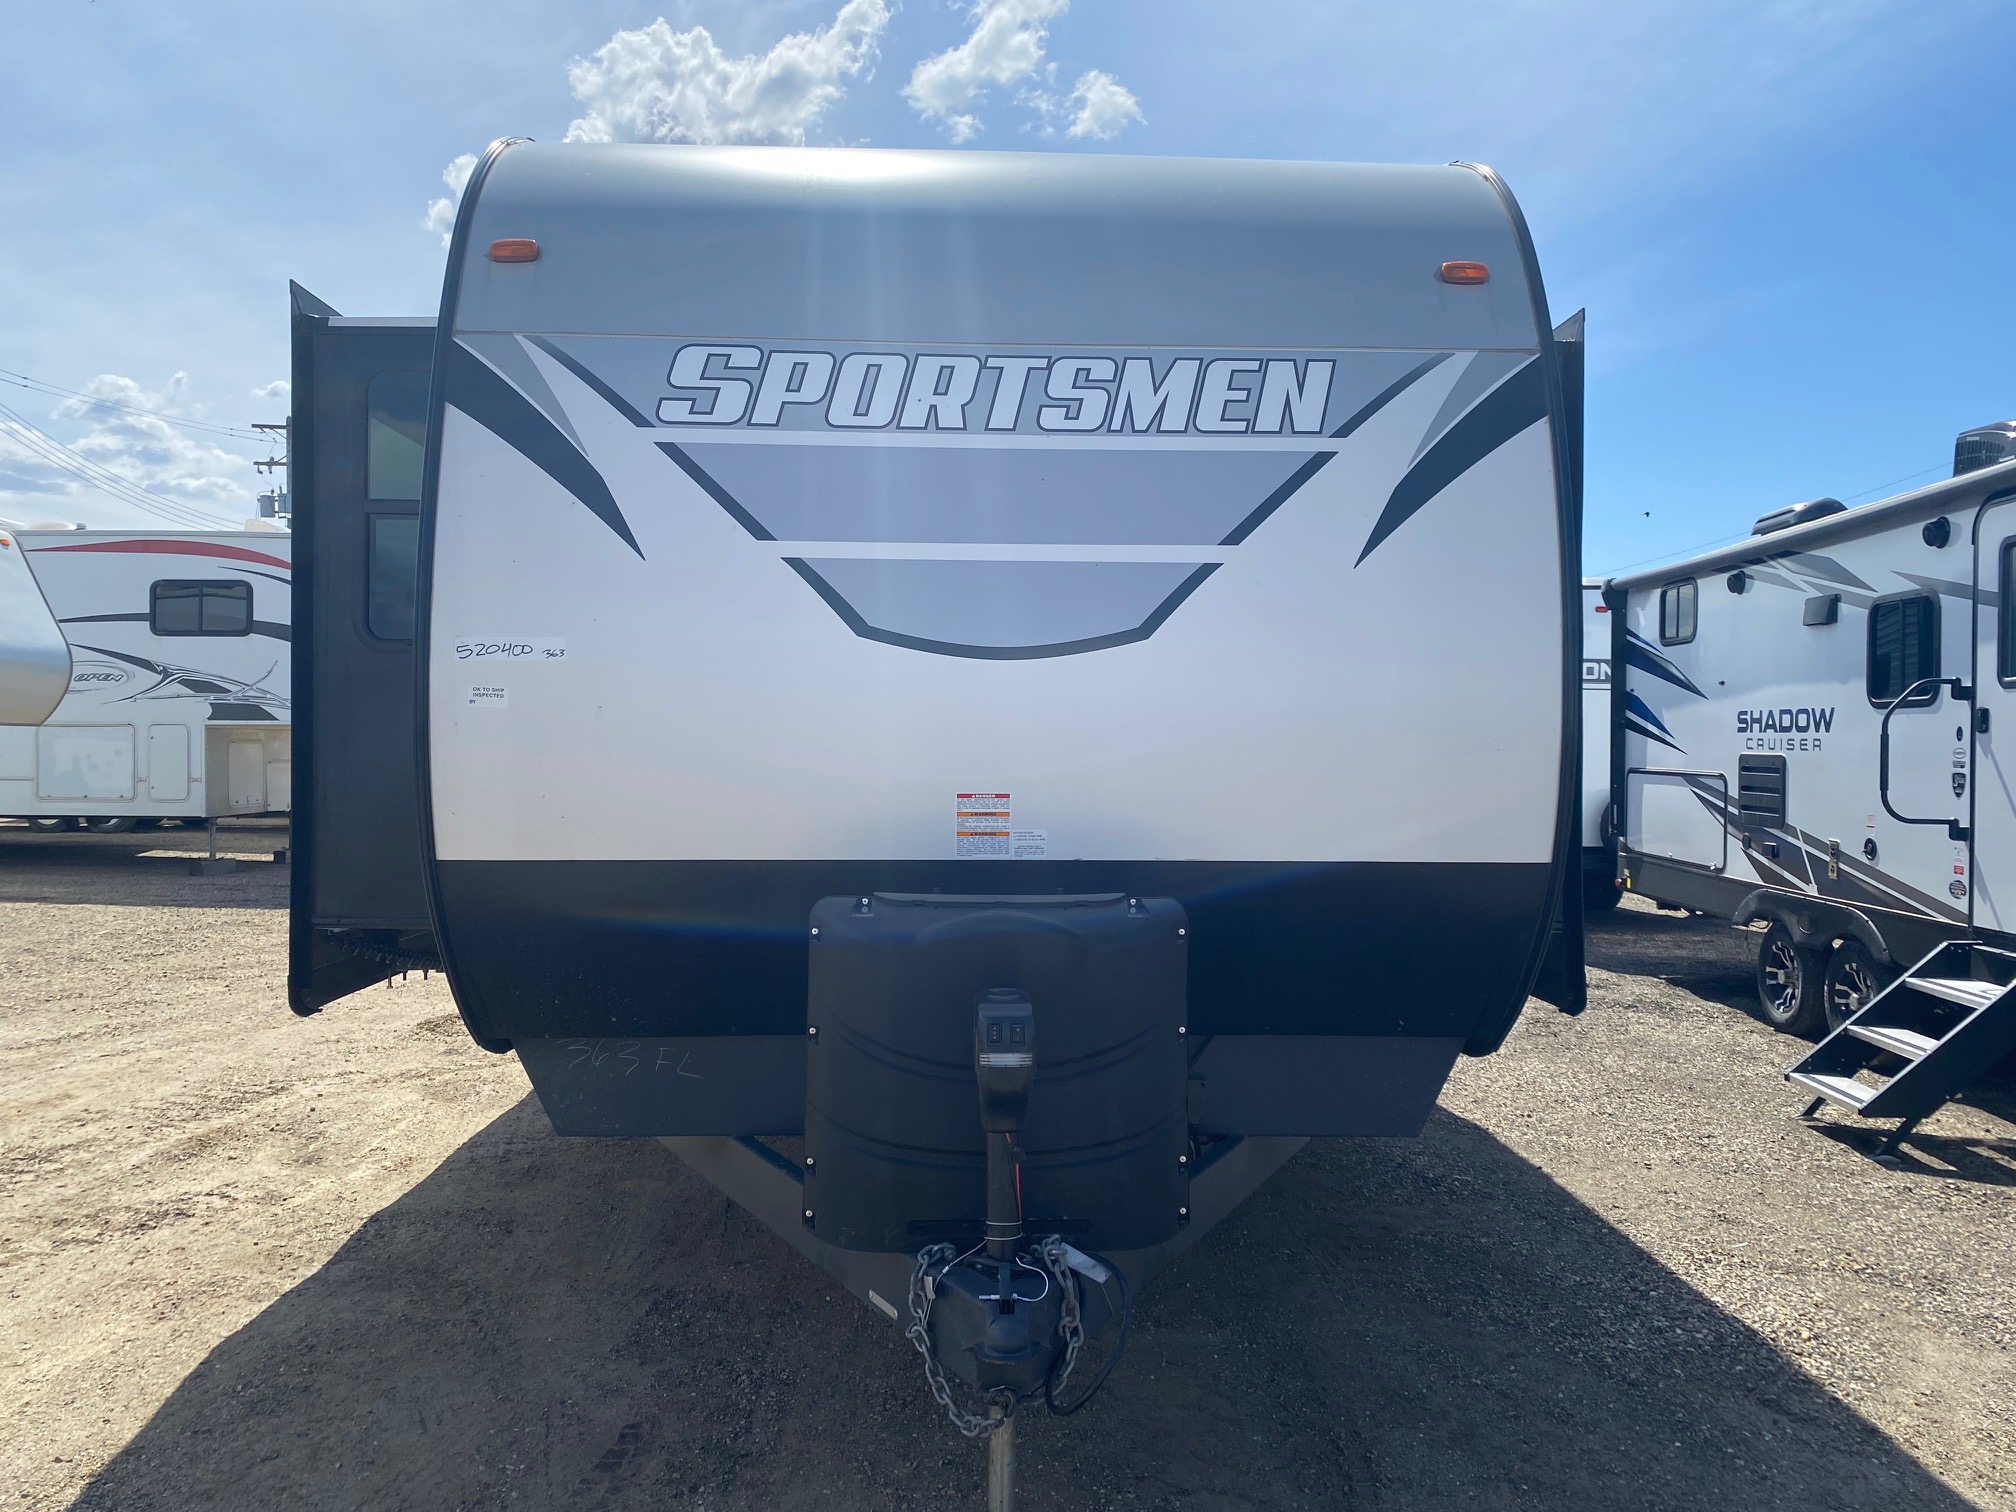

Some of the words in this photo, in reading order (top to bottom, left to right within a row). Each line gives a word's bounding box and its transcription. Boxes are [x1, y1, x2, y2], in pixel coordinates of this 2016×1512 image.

[656, 344, 1337, 434] SPORTSMEN
[456, 643, 533, 659] 520400
[74, 673, 124, 682] OPEN
[1737, 707, 1835, 733] SHADOW
[1746, 738, 1822, 751] CRUISER
[655, 1047, 703, 1079] FL
